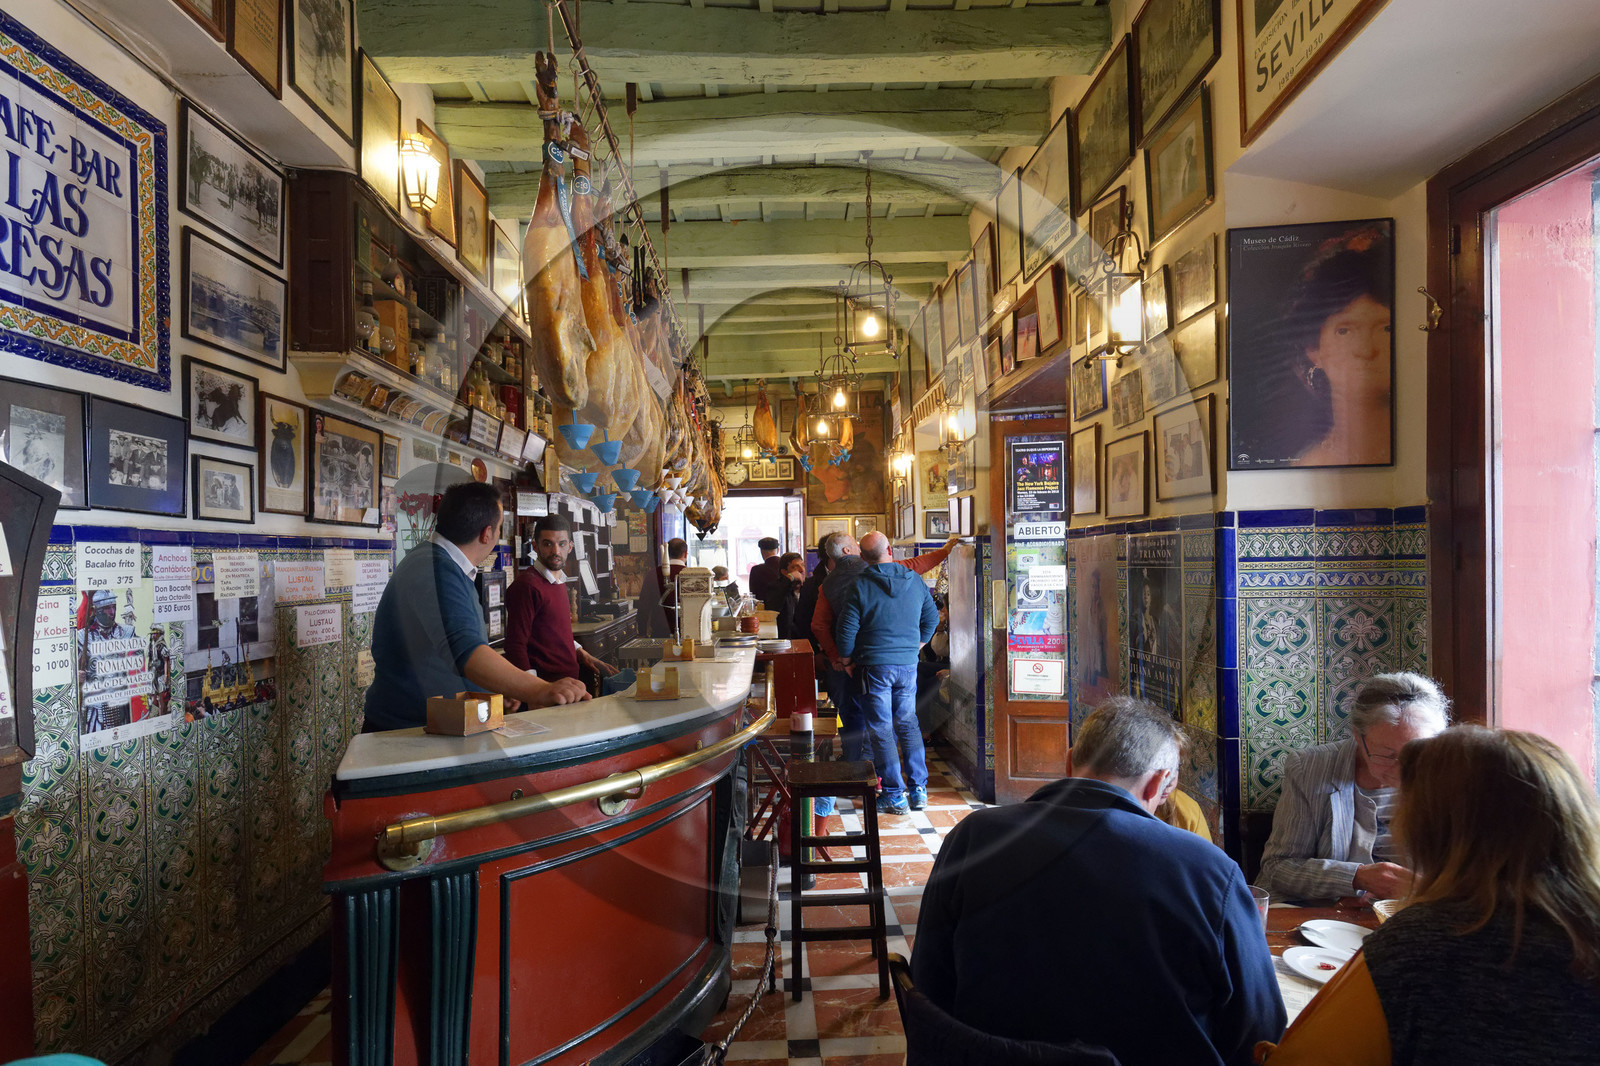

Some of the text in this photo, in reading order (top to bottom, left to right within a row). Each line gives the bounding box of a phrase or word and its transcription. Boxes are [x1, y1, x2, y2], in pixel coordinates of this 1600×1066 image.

[6, 149, 89, 238] LAS
[1278, 234, 1300, 242] Cádiz
[1018, 526, 1060, 535] ABIERTO
[85, 546, 134, 554] Cocochas de
[1140, 550, 1172, 558] TRIANON
[154, 565, 191, 573] Cantábrico
[88, 576, 133, 586] Tapa 3'75
[36, 601, 59, 609] cina
[158, 604, 172, 613] 8'50
[37, 614, 49, 623] de
[310, 618, 333, 627] LUSTAU
[44, 627, 67, 636] Kobe
[1009, 635, 1044, 646] SEVILLA
[51, 643, 68, 652] 3'50
[92, 638, 147, 654] III JORNADAS
[47, 659, 69, 670] 10'00
[98, 656, 143, 674] ROMANAS
[1152, 656, 1180, 670] FLAMENCO
[1130, 663, 1180, 687] JUANA AMAYA
[84, 682, 88, 691] 4
[91, 681, 102, 690] AL
[112, 678, 123, 686] DE
[125, 673, 154, 684] MARZO
[87, 694, 113, 703] ALAMEDA
